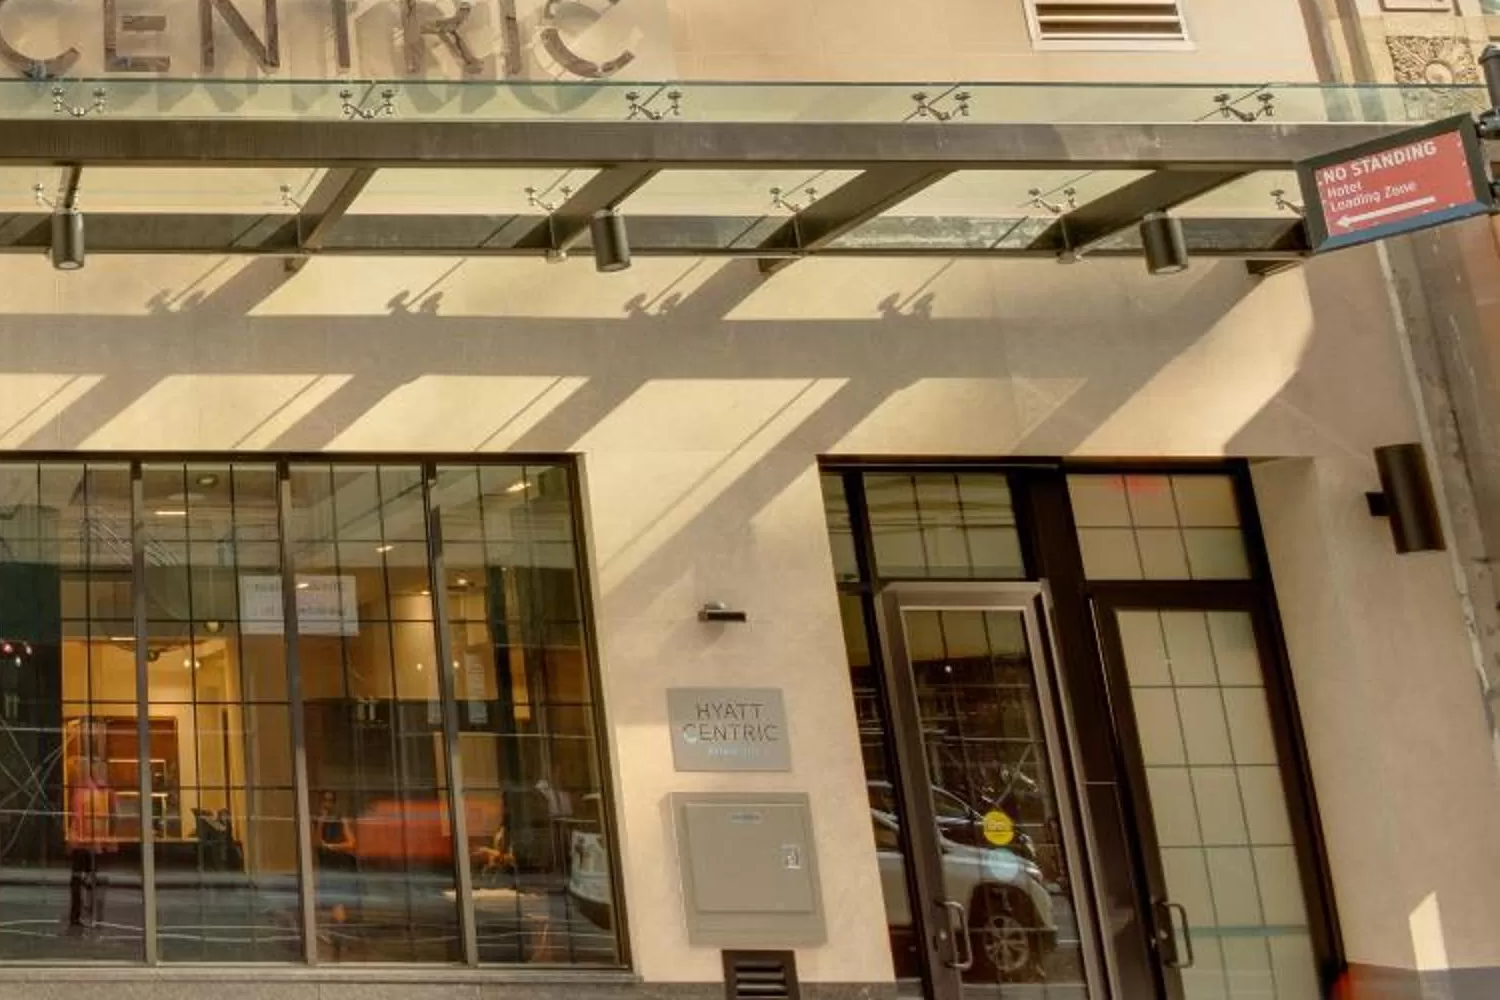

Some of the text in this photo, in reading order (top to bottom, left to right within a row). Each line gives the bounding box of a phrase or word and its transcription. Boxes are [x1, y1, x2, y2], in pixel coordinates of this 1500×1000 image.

[1323, 140, 1438, 185] NO STANDING
[1327, 180, 1364, 199] Hotel
[1330, 180, 1418, 213] Loading Zone
[695, 702, 765, 721] HYATT
[682, 723, 781, 743] CENTRIC
